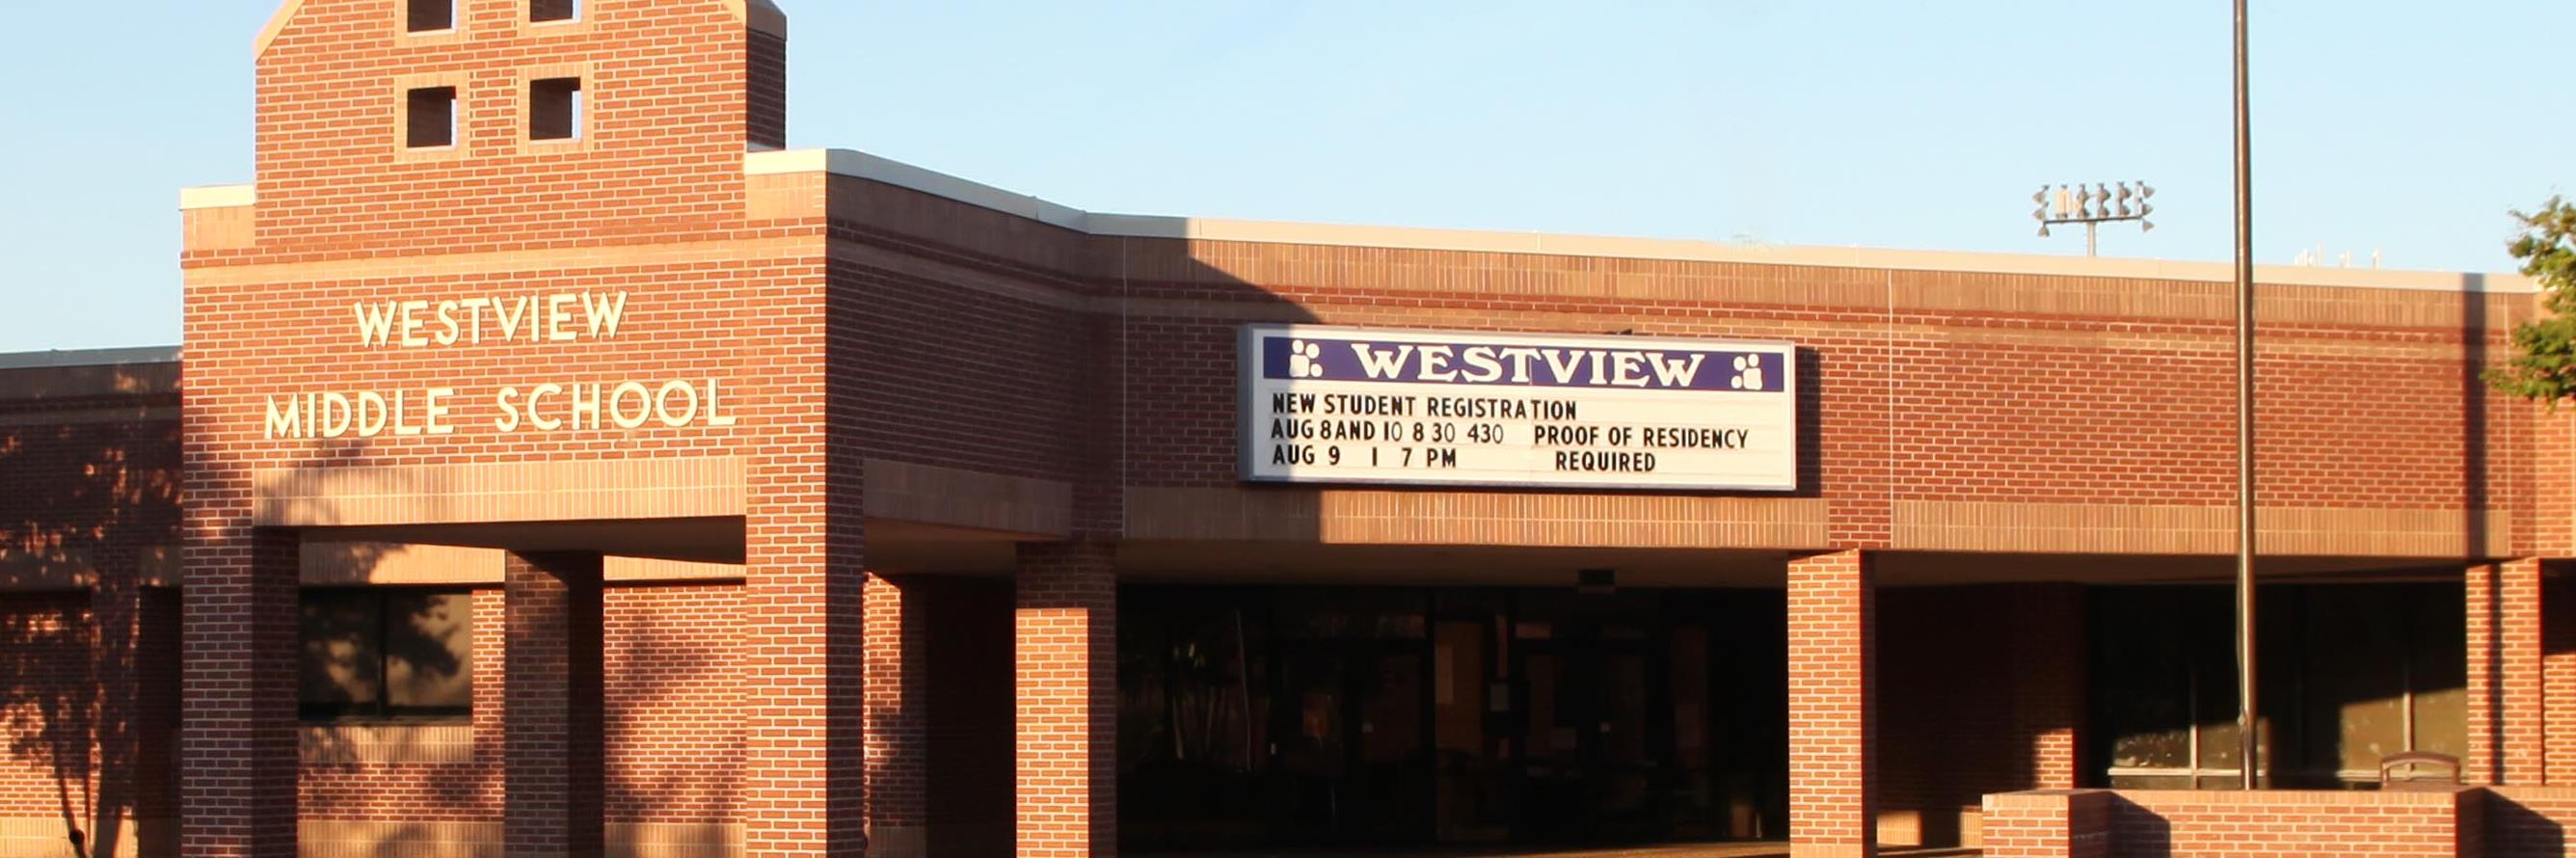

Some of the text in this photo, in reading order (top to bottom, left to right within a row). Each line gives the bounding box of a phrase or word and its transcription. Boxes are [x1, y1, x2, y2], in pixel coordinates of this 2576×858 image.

[354, 291, 628, 348] WESTVIEW
[1351, 342, 1705, 388] WESTVIEW
[264, 378, 738, 440] MIDDLE SCHOOL
[1273, 392, 1576, 420] NEW STUDENT REGISTRATION
[1271, 417, 1315, 440] AUG
[1383, 421, 1403, 442] 10
[1412, 421, 1425, 442] 8
[1432, 422, 1456, 443] 30
[1467, 423, 1504, 444] 430
[1534, 425, 1749, 449] PROOF OF RESIDENCY
[1272, 443, 1315, 466] AUG
[1328, 445, 1340, 466] 9
[1402, 447, 1412, 468] 7
[1427, 447, 1457, 469] PM
[1555, 450, 1656, 472] REQUIRED
